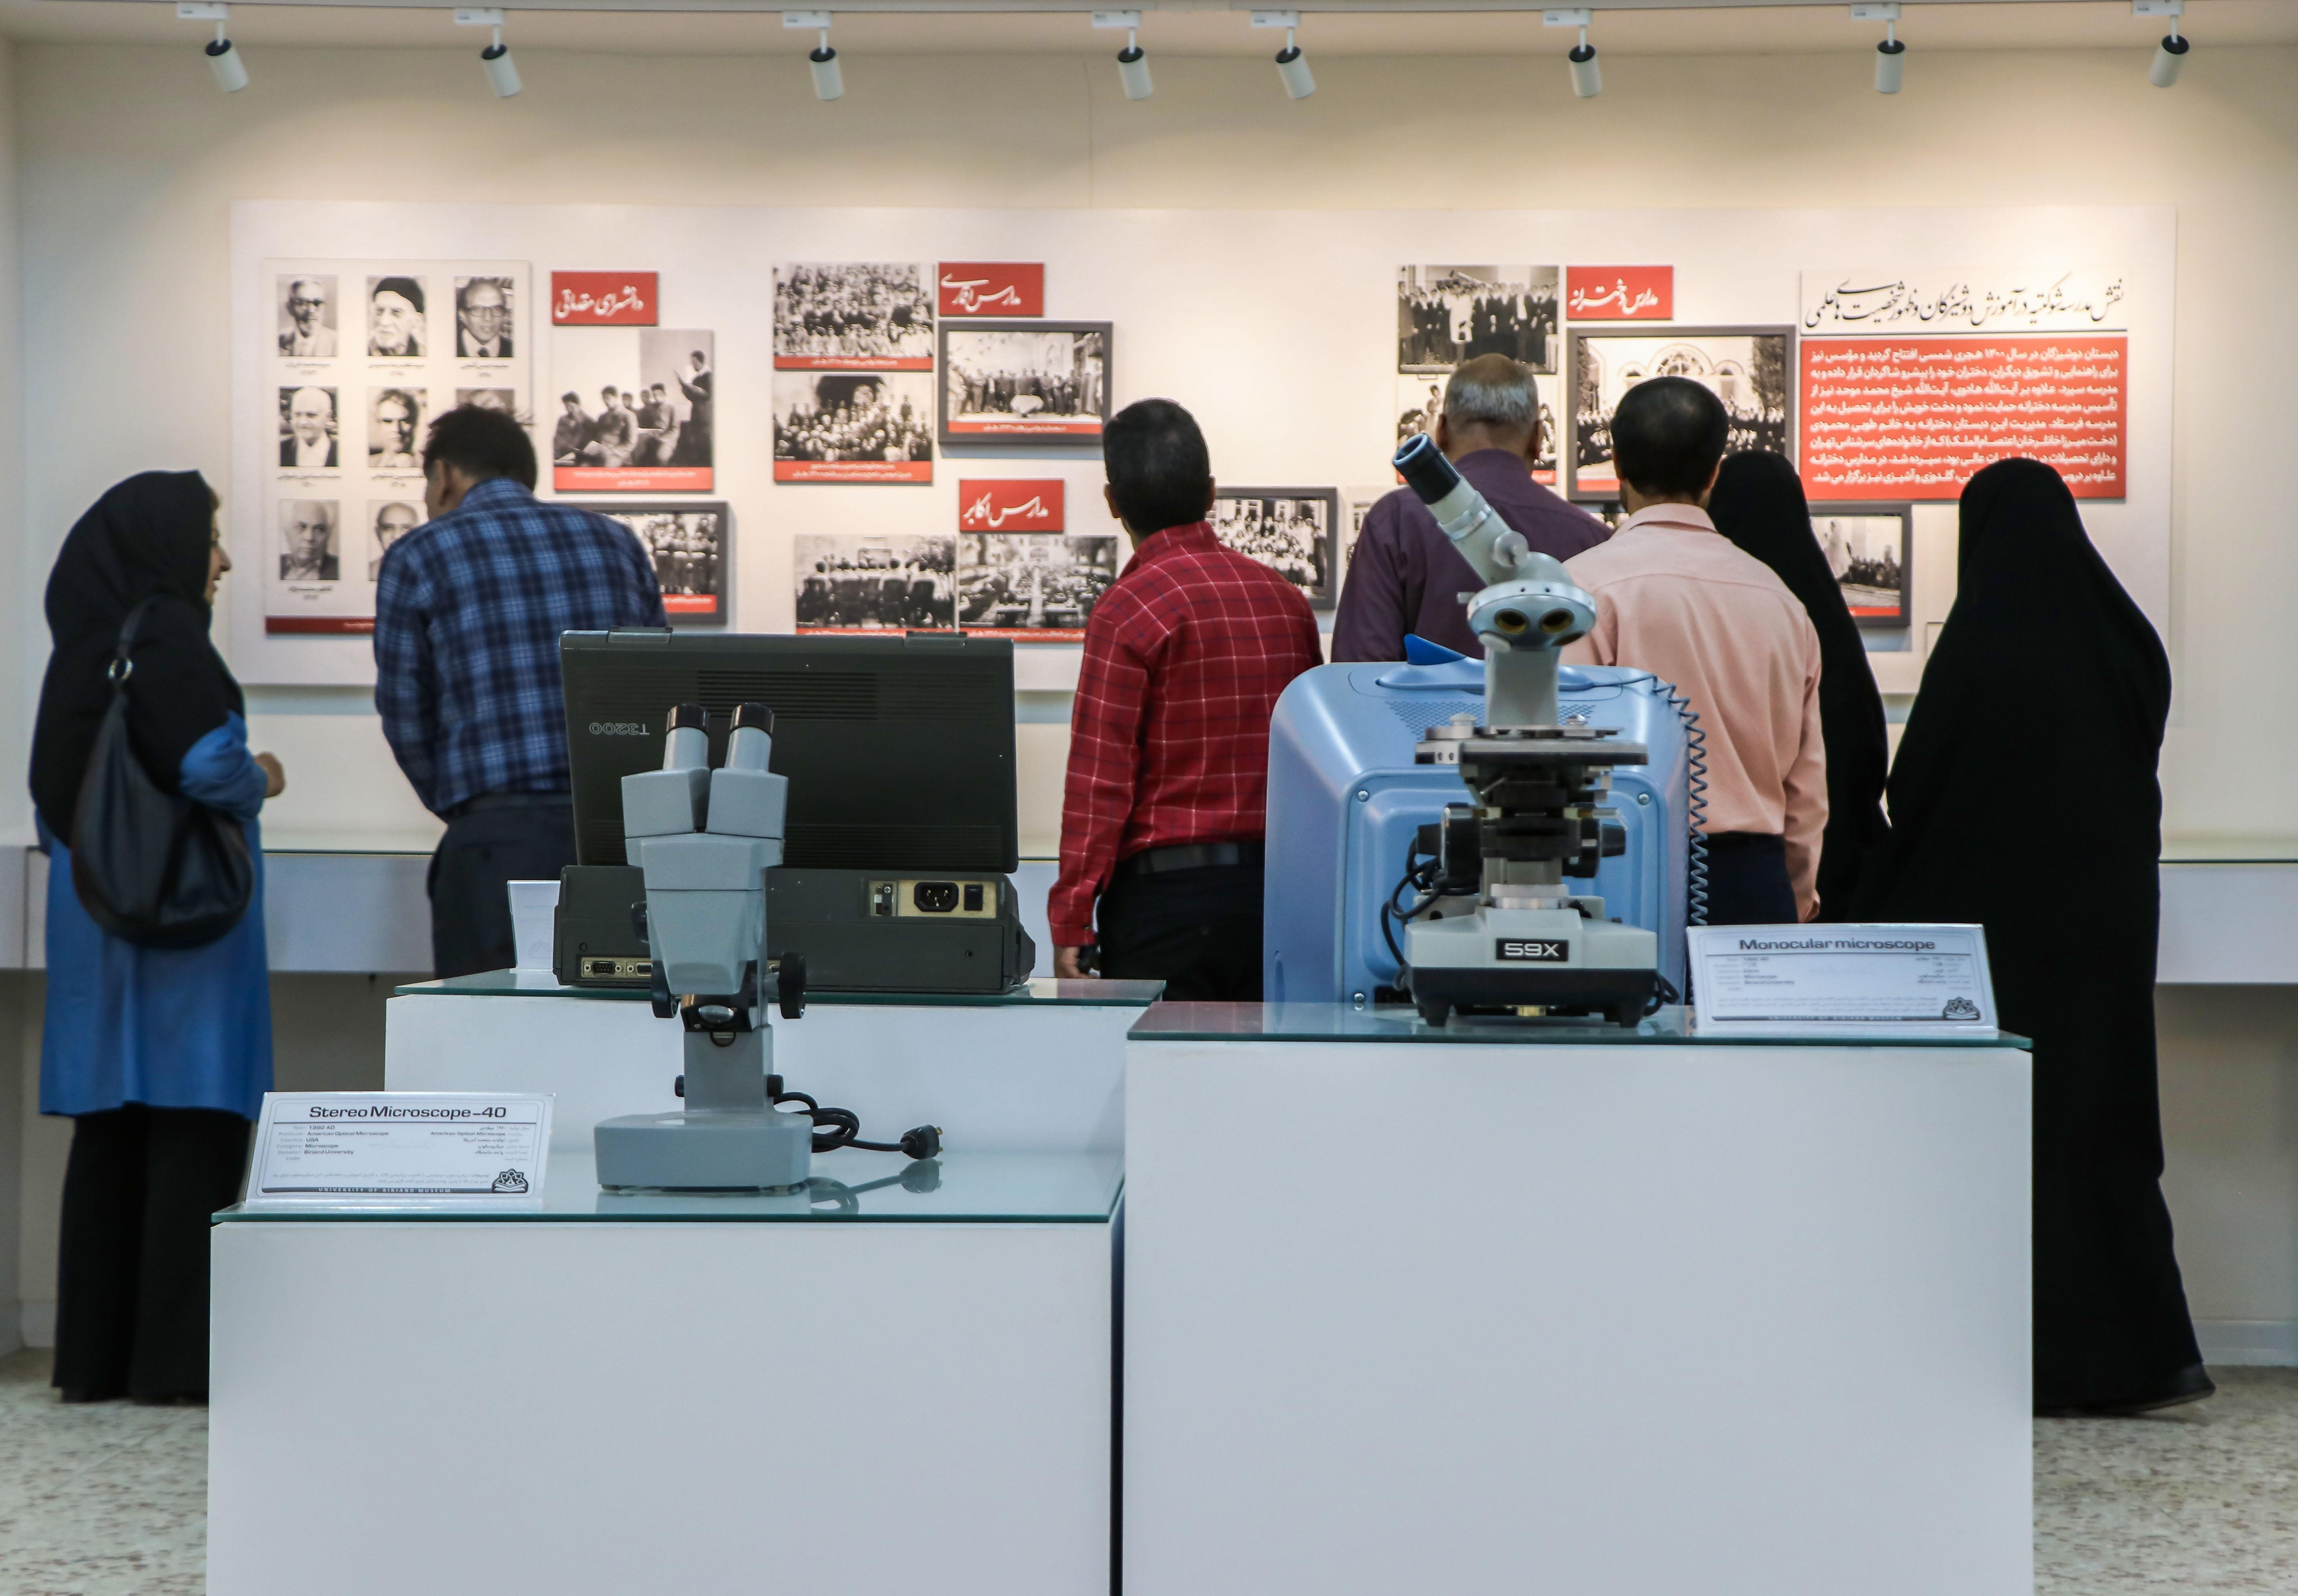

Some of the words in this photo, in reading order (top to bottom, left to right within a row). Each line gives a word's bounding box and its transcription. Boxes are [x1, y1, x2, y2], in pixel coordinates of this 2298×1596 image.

[964, 284, 1022, 313] مدارس
[1568, 278, 1629, 312] دخترانه
[1622, 286, 1659, 315] مدارس
[1919, 282, 1973, 322] دوشیزگان
[2029, 271, 2073, 324] شوکتیه
[2091, 278, 2124, 322] نقش
[1805, 291, 1836, 328] علمی
[1970, 287, 2027, 326] آموزش
[1810, 350, 1824, 363] نیز
[1860, 352, 1866, 363] و
[1866, 347, 1891, 363] گردید
[1892, 348, 1918, 363] افتتاح
[1918, 349, 1953, 363] شمسی
[1953, 350, 1984, 362] هجری
[2006, 347, 2028, 362] سال
[2028, 350, 2039, 361] در
[2039, 346, 2083, 362] دوشیزگان
[2084, 346, 2119, 362] دبستان
[1810, 369, 1821, 379] به
[1821, 370, 1827, 380] و
[1827, 366, 1846, 379] داده
[1846, 365, 1863, 380] قرار
[1863, 365, 1900, 381] شاگردان
[1928, 365, 1936, 379] را
[1936, 366, 1956, 379] خود
[1956, 365, 1988, 379] دختران
[2022, 365, 2053, 380] تشویق
[2053, 369, 2060, 379] و
[2060, 364, 2099, 379] راهنمایی
[2099, 364, 2119, 379] برای
[1810, 383, 1819, 398] از
[1819, 385, 1835, 398] نیز
[1862, 386, 1890, 396] محمد
[1890, 384, 1914, 398] شیخ
[2019, 386, 2030, 397] بر
[2031, 382, 2057, 397] علاوه
[2086, 385, 2118, 396] مدرسه
[1810, 401, 1826, 416] این
[1825, 404, 1837, 414] به
[1837, 401, 1872, 416] تحصیل
[1872, 400, 1892, 415] برای
[1891, 400, 1899, 415] را
[1956, 404, 1963, 415] و
[1985, 400, 2017, 414] حمایت
[2017, 399, 2051, 414] دخترانه
[2051, 402, 2083, 414] مدرسه
[1810, 421, 1851, 433] محمودی
[1877, 418, 1903, 433] خانم
[1903, 421, 1917, 431] به
[1917, 417, 1953, 431] دخترانه
[1953, 417, 1990, 432] دبستان
[1990, 417, 2009, 432] این
[2009, 419, 2047, 431] مدیریت
[2085, 419, 2118, 431] مدرسه
[1810, 435, 1836, 450] تهران
[1834, 436, 1875, 450] سرشناس
[1923, 435, 1931, 448] از
[1809, 452, 1844, 468] دخترانه
[1844, 452, 1877, 468] مدارس
[1877, 455, 1888, 467] در
[1909, 454, 1942, 466] سپرده
[1959, 452, 1985, 467] عالی
[2048, 452, 2089, 466] تحصیلات
[2090, 451, 2111, 466] دارای
[2110, 455, 2118, 466] و
[1844, 469, 1867, 484] برگزار
[1883, 468, 1915, 484] آشپزی
[1915, 474, 1921, 484] و
[1921, 468, 1954, 484] گلدوزی
[2083, 473, 2092, 483] بر
[2092, 469, 2116, 483] علاوه
[962, 492, 993, 526] اکابر
[987, 495, 1049, 527] مدارس
[589, 723, 650, 735] T3200
[1504, 942, 1560, 956] 59X
[1739, 938, 1832, 950] Monocular
[1835, 938, 1935, 951] microscope
[309, 1106, 367, 1118] Stereo
